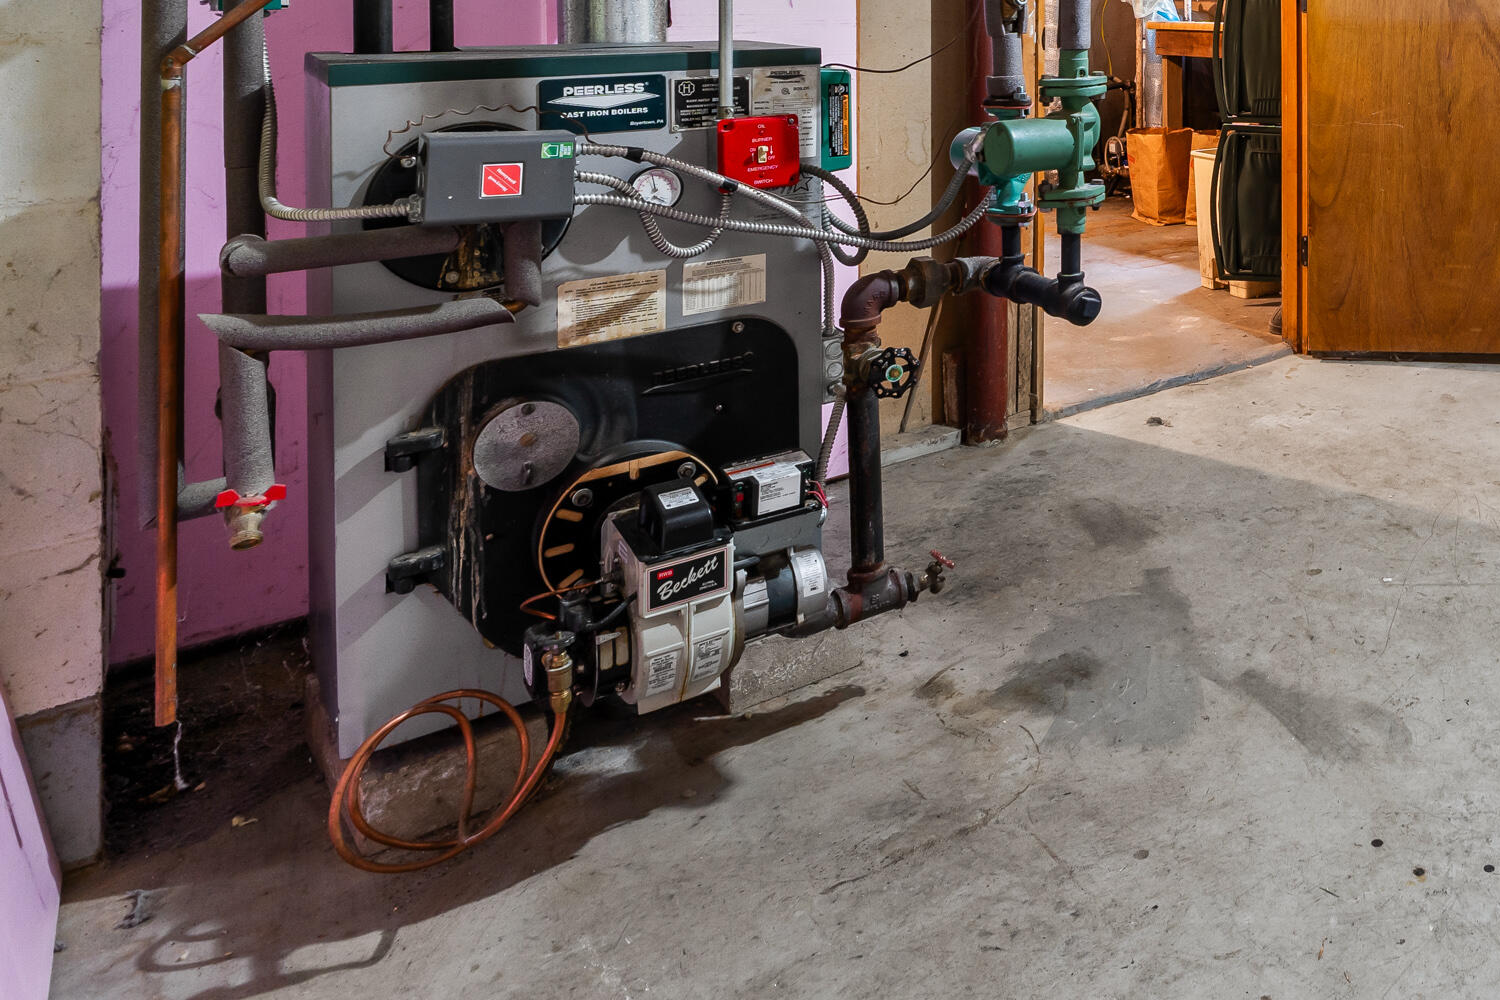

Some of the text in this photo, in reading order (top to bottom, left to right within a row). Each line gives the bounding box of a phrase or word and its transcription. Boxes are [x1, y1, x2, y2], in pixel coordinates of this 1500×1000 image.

[563, 82, 645, 97] PEERLESS
[586, 109, 610, 117] IRON
[611, 107, 649, 115] BOILERS
[747, 164, 778, 172] EMERGENCY
[657, 556, 719, 600] Beckett
